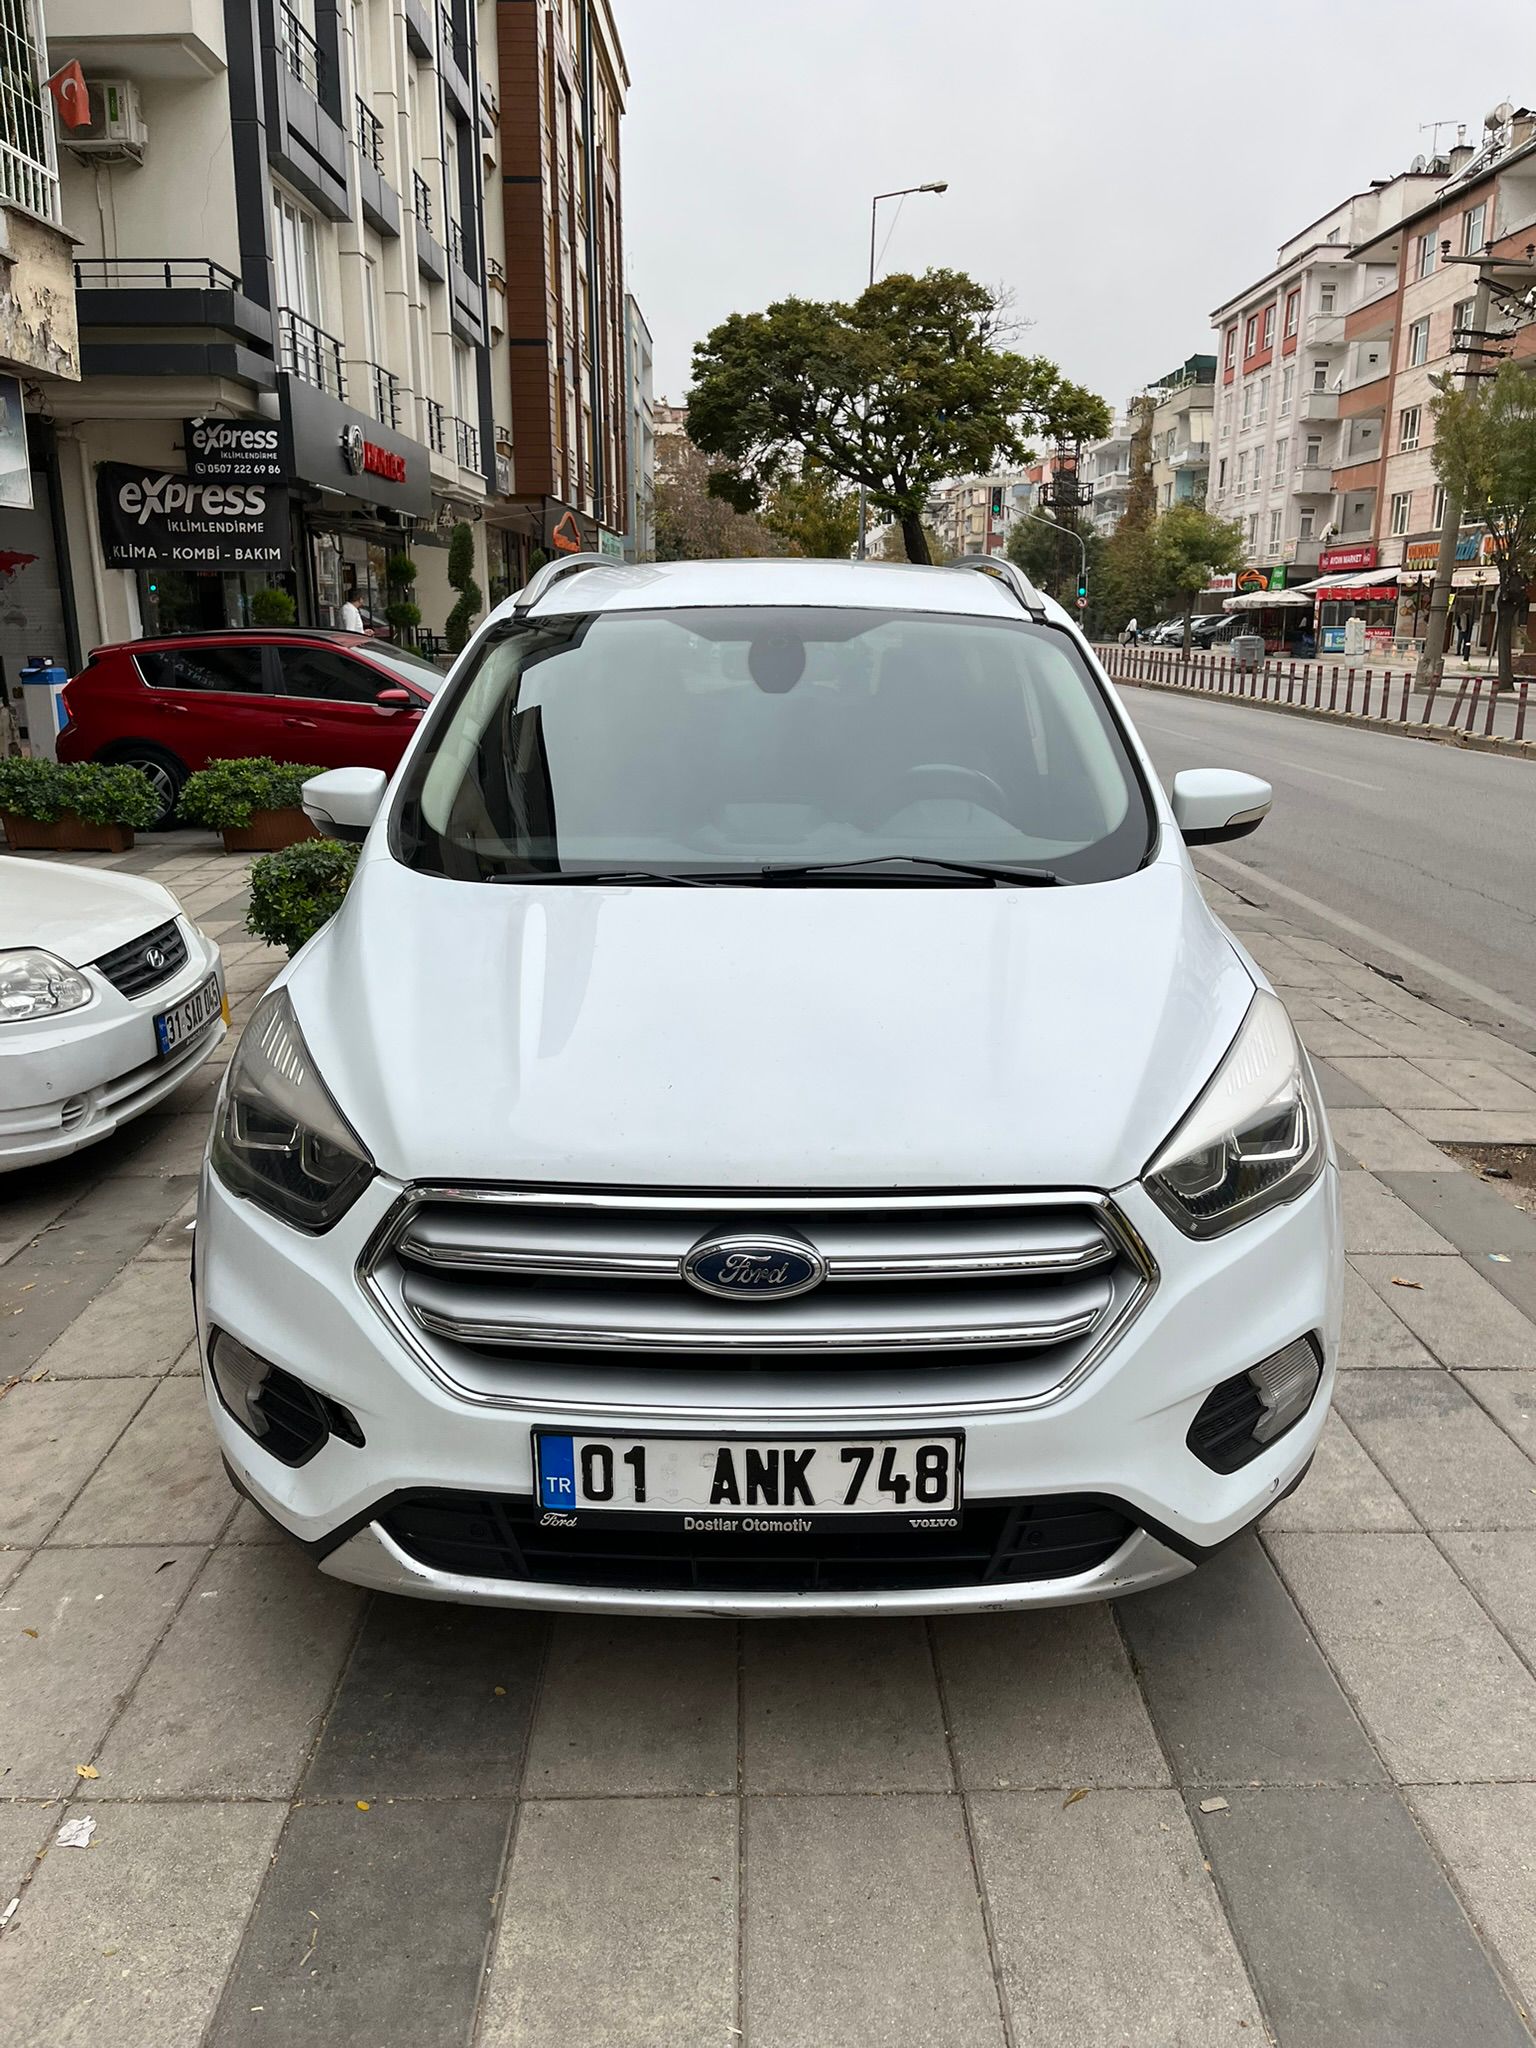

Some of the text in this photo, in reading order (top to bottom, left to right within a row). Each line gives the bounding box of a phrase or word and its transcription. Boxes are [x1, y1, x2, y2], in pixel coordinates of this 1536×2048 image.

[221, 451, 278, 460] İKLİMLENDİRME
[207, 464, 281, 474] 0507 222 69 86
[167, 519, 264, 533] İKLİMLENDİRME
[113, 544, 158, 559] KLİMA
[173, 545, 220, 560] KOMBİ
[235, 548, 281, 560] BAKIM
[166, 1011, 181, 1044] 31
[718, 1253, 789, 1283] Ford
[580, 1444, 949, 1506] 01 ANK 748
[546, 1476, 571, 1493] TR
[539, 1512, 577, 1527] Ford
[684, 1517, 812, 1532] Dostlar Otomotiv
[909, 1518, 958, 1528] VOLVO
